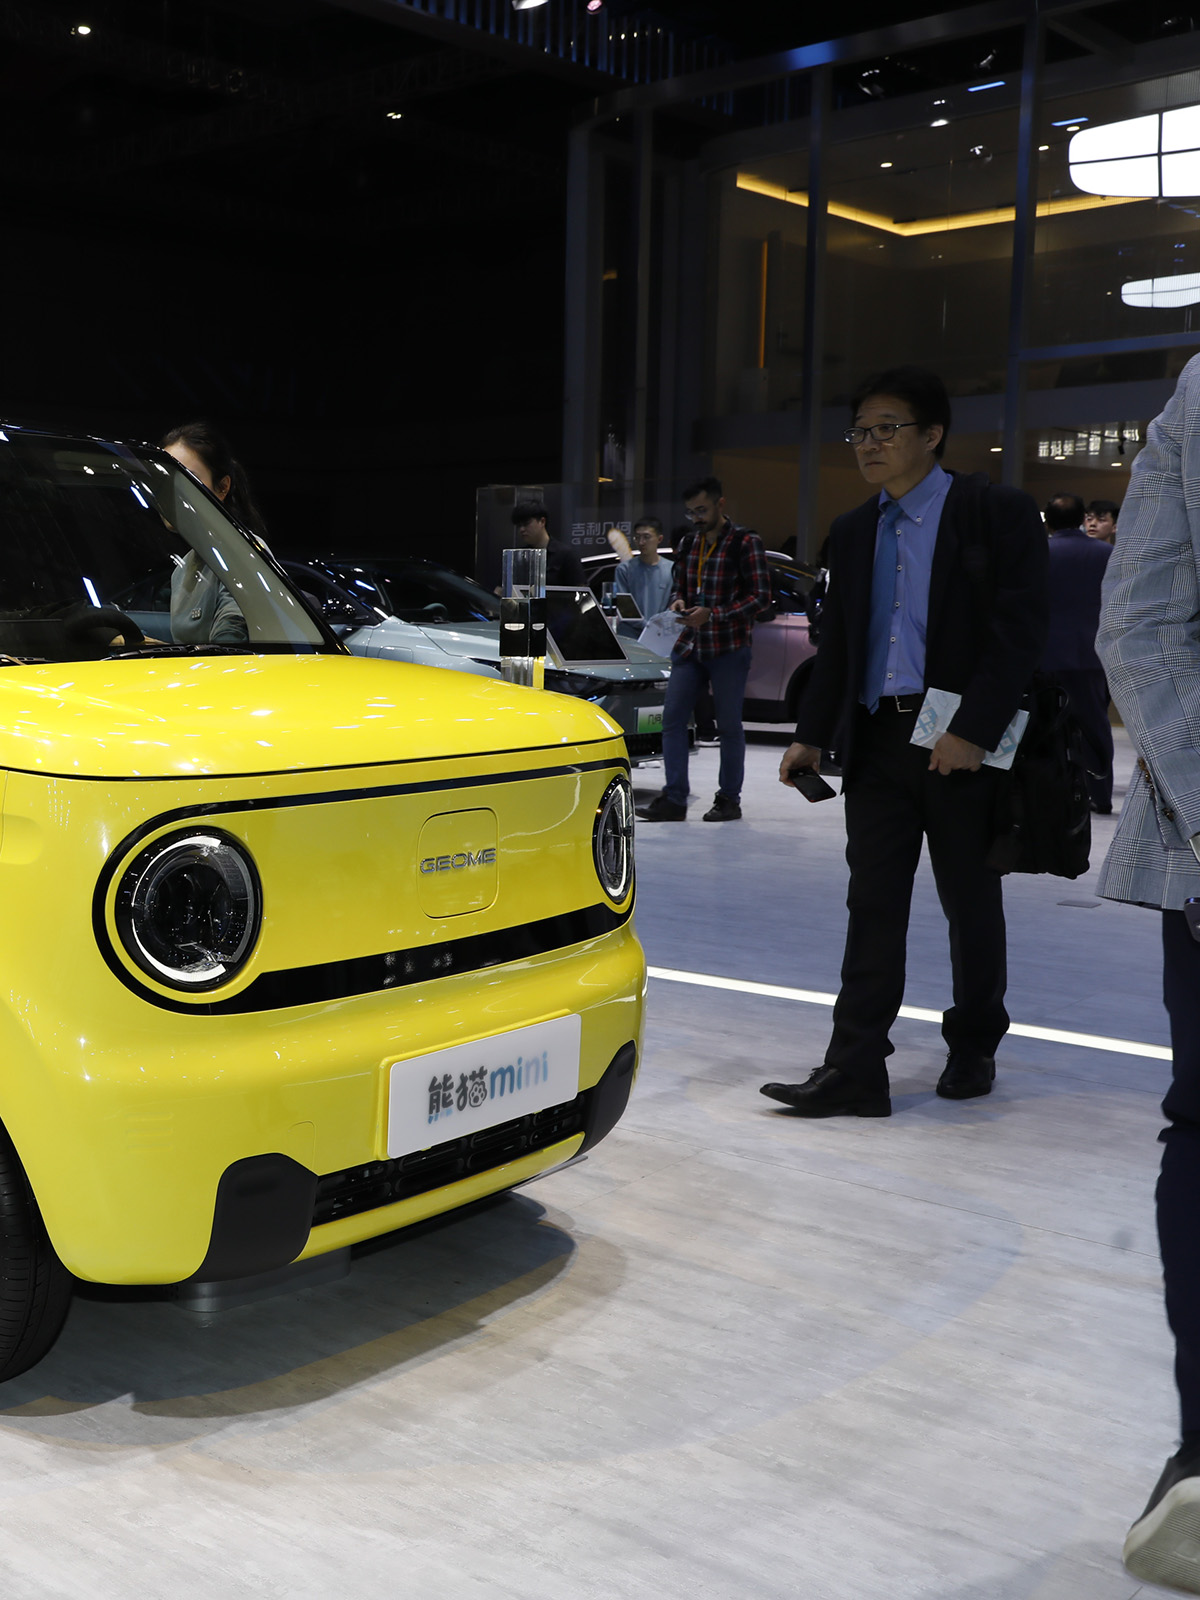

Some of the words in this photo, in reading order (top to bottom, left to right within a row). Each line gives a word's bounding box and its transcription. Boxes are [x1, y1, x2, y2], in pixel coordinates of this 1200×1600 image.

[571, 521, 632, 536] 吉利几何
[420, 847, 496, 874] GEOME
